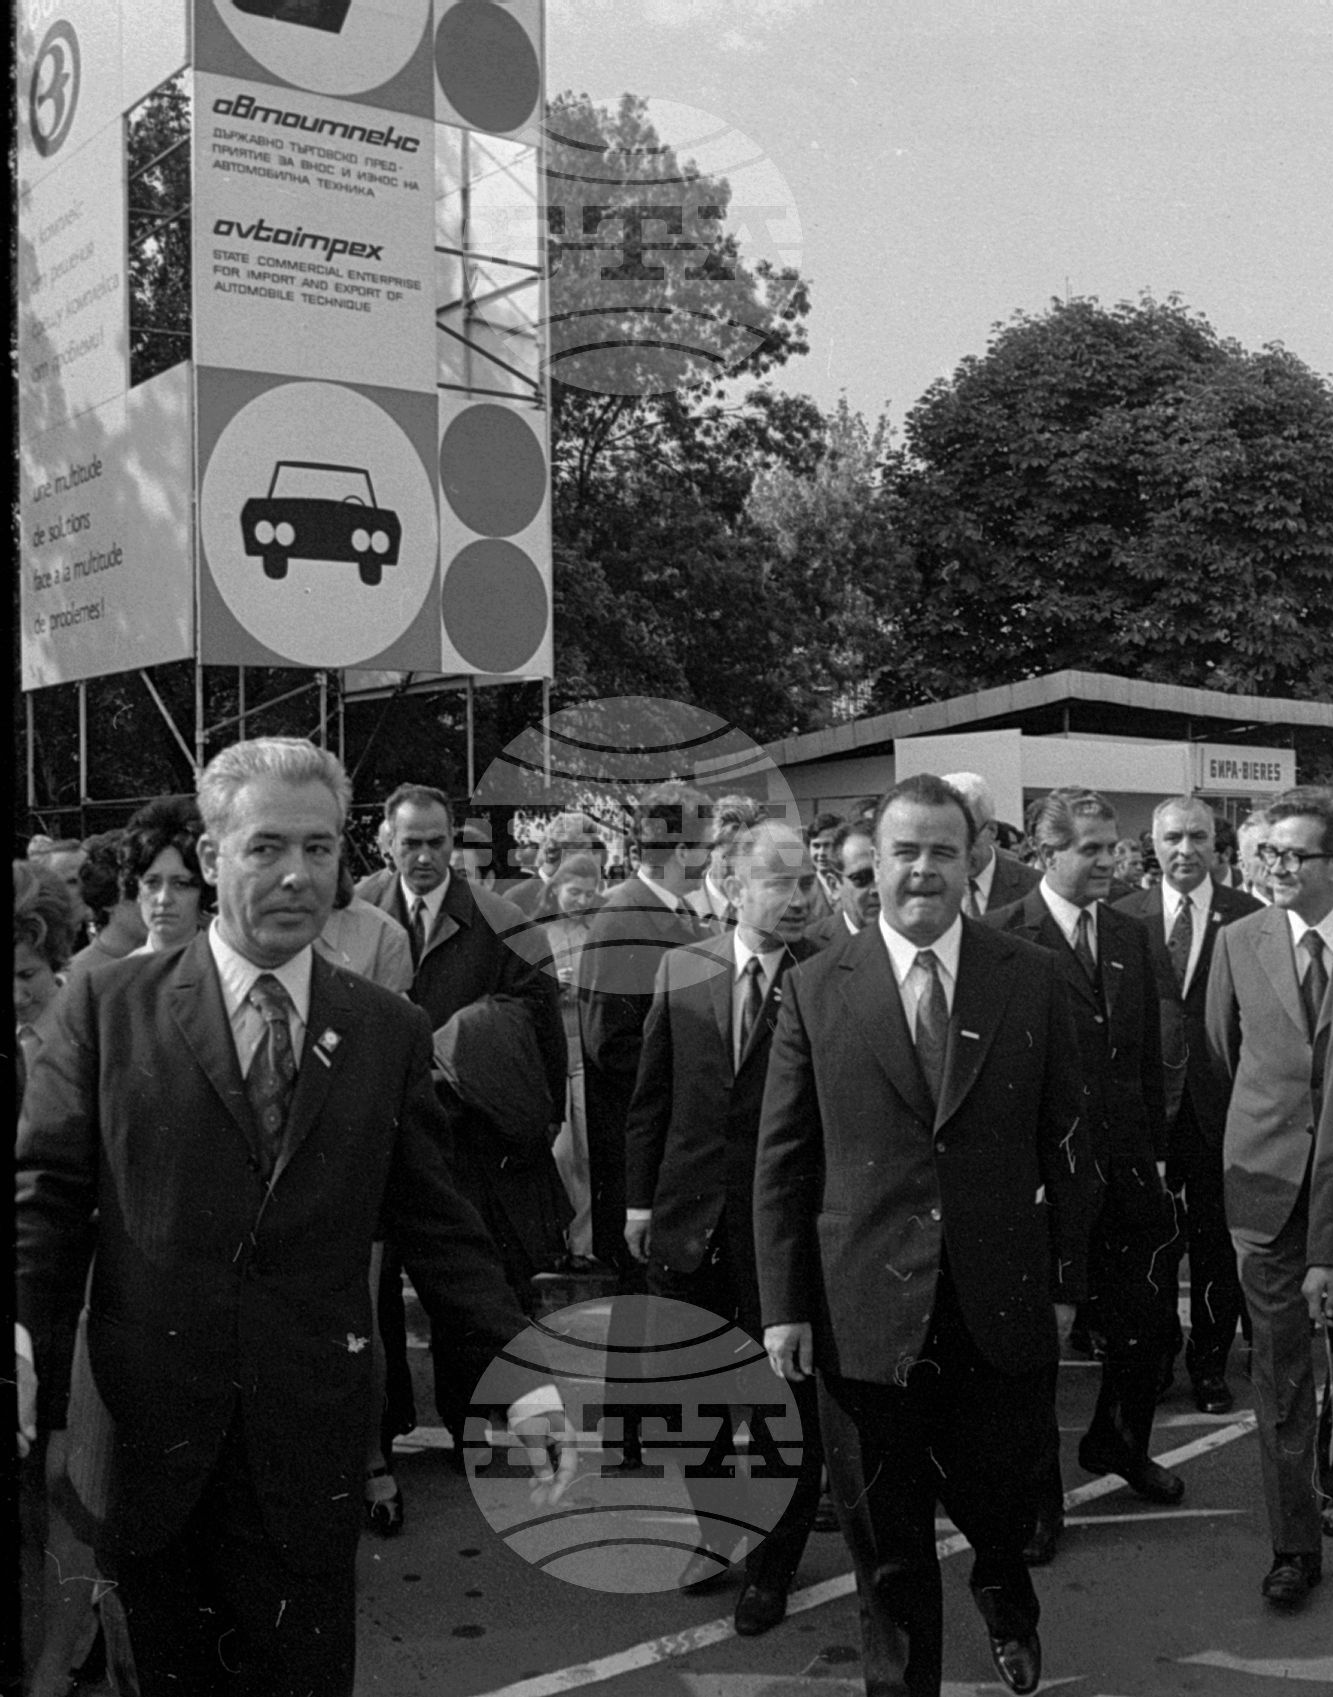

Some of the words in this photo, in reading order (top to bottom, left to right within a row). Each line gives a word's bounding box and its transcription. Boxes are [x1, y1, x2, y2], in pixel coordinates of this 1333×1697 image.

[212, 143, 271, 163] ПРИЯТИЕ
[278, 155, 295, 167] ЗА
[301, 160, 335, 175] ВНОС
[341, 166, 352, 178] И
[356, 170, 398, 188] ИЗНОС
[403, 180, 420, 191] НА
[213, 127, 284, 149] ДЪРЖАВНО
[289, 141, 358, 164] ТЪРГОВСКО
[364, 156, 404, 172] ПРЕД-
[213, 159, 310, 185] АВТОМОБИЛНА
[316, 177, 376, 198] ТЕХНИКА
[213, 249, 250, 264] STATE
[257, 255, 343, 279] COMMERCIAL
[347, 269, 422, 291] ENTERPRISE
[213, 264, 241, 278] FOR
[247, 269, 295, 286] IMPORT
[301, 278, 329, 291] AND
[334, 282, 381, 299] EXPORT
[387, 290, 404, 301] OF
[214, 281, 295, 302] AUTOMOBILE
[300, 292, 372, 313] TECHNIQUE
[33, 524, 46, 548] de
[33, 611, 46, 635] de
